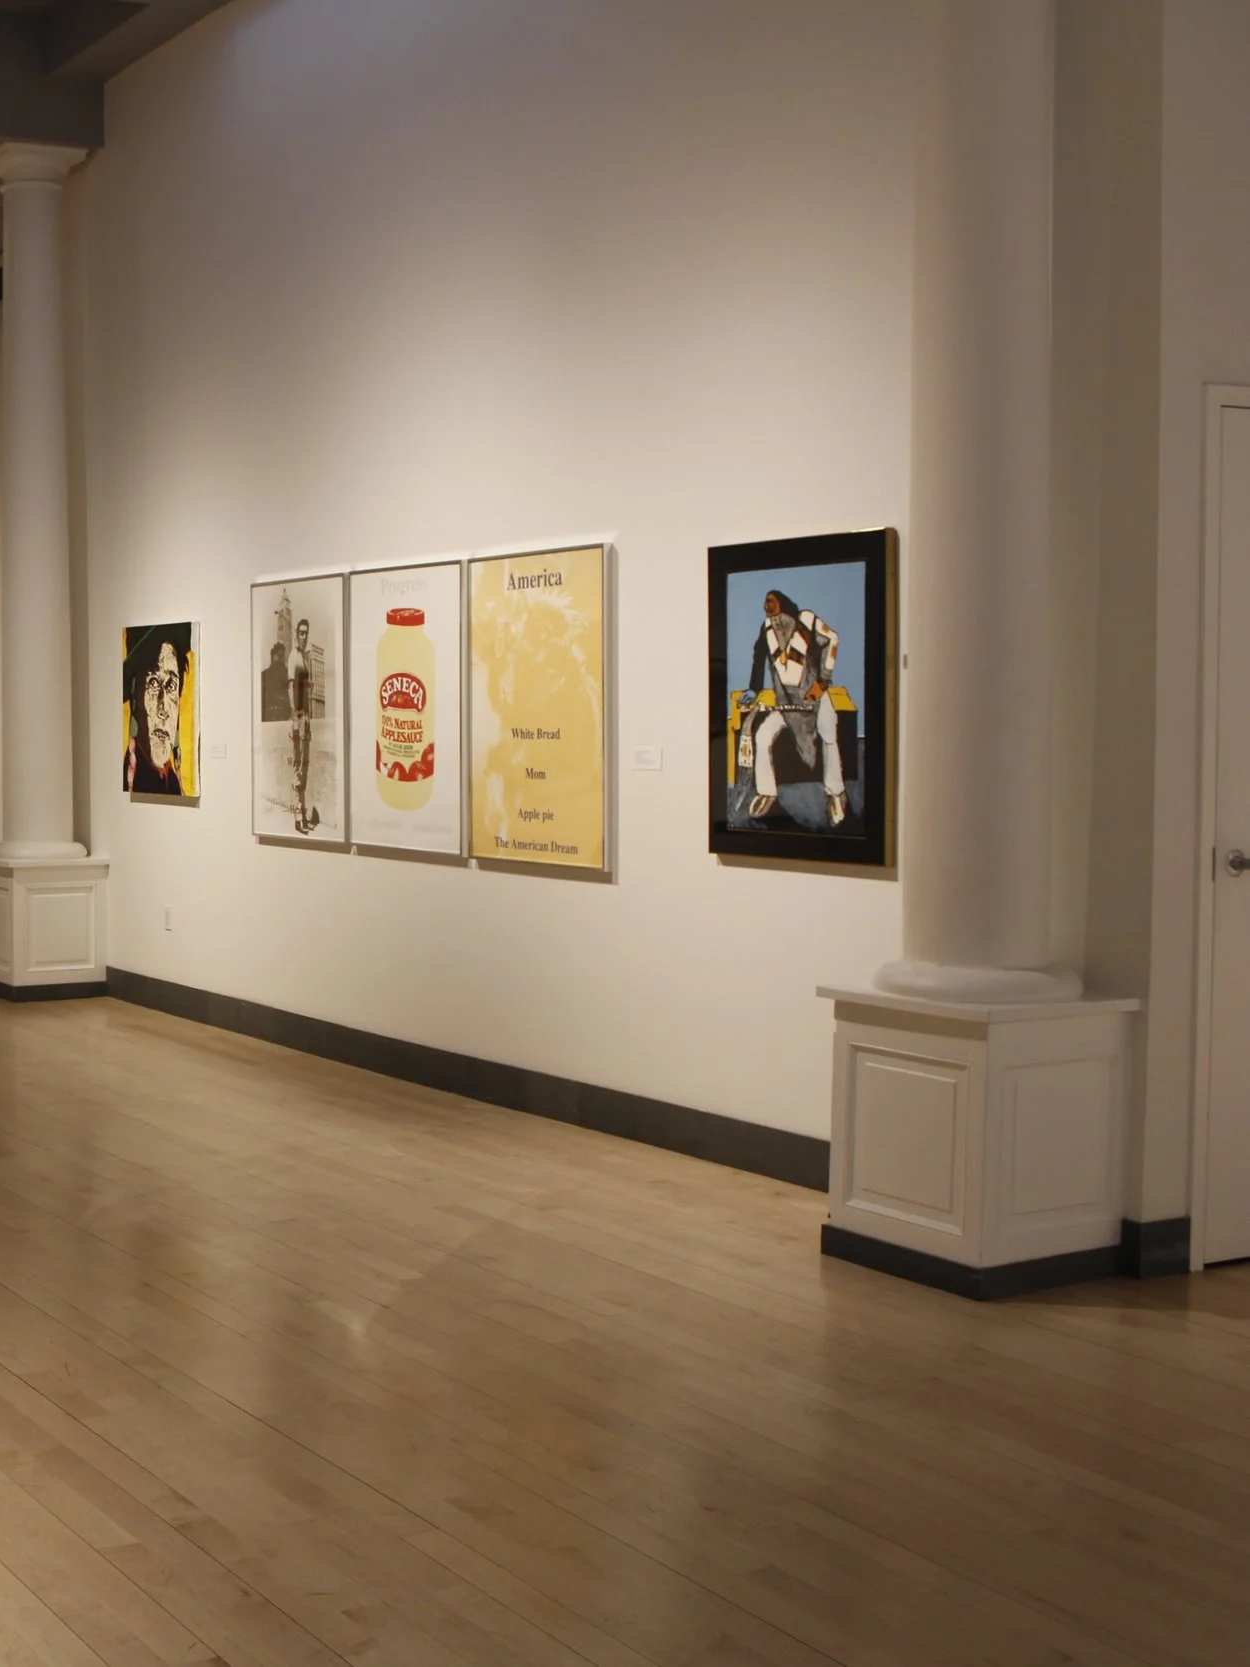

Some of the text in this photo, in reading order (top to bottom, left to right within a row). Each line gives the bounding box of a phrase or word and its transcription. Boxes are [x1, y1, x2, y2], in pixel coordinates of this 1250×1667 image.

[507, 568, 562, 591] America
[381, 676, 423, 710] SENECA
[394, 718, 422, 730] NATURAL
[381, 726, 423, 743] APPLESAUCE
[511, 727, 561, 740] White Bread
[525, 767, 546, 780] Mom
[518, 808, 554, 823] Apple pie
[494, 836, 578, 855] The American Dream
